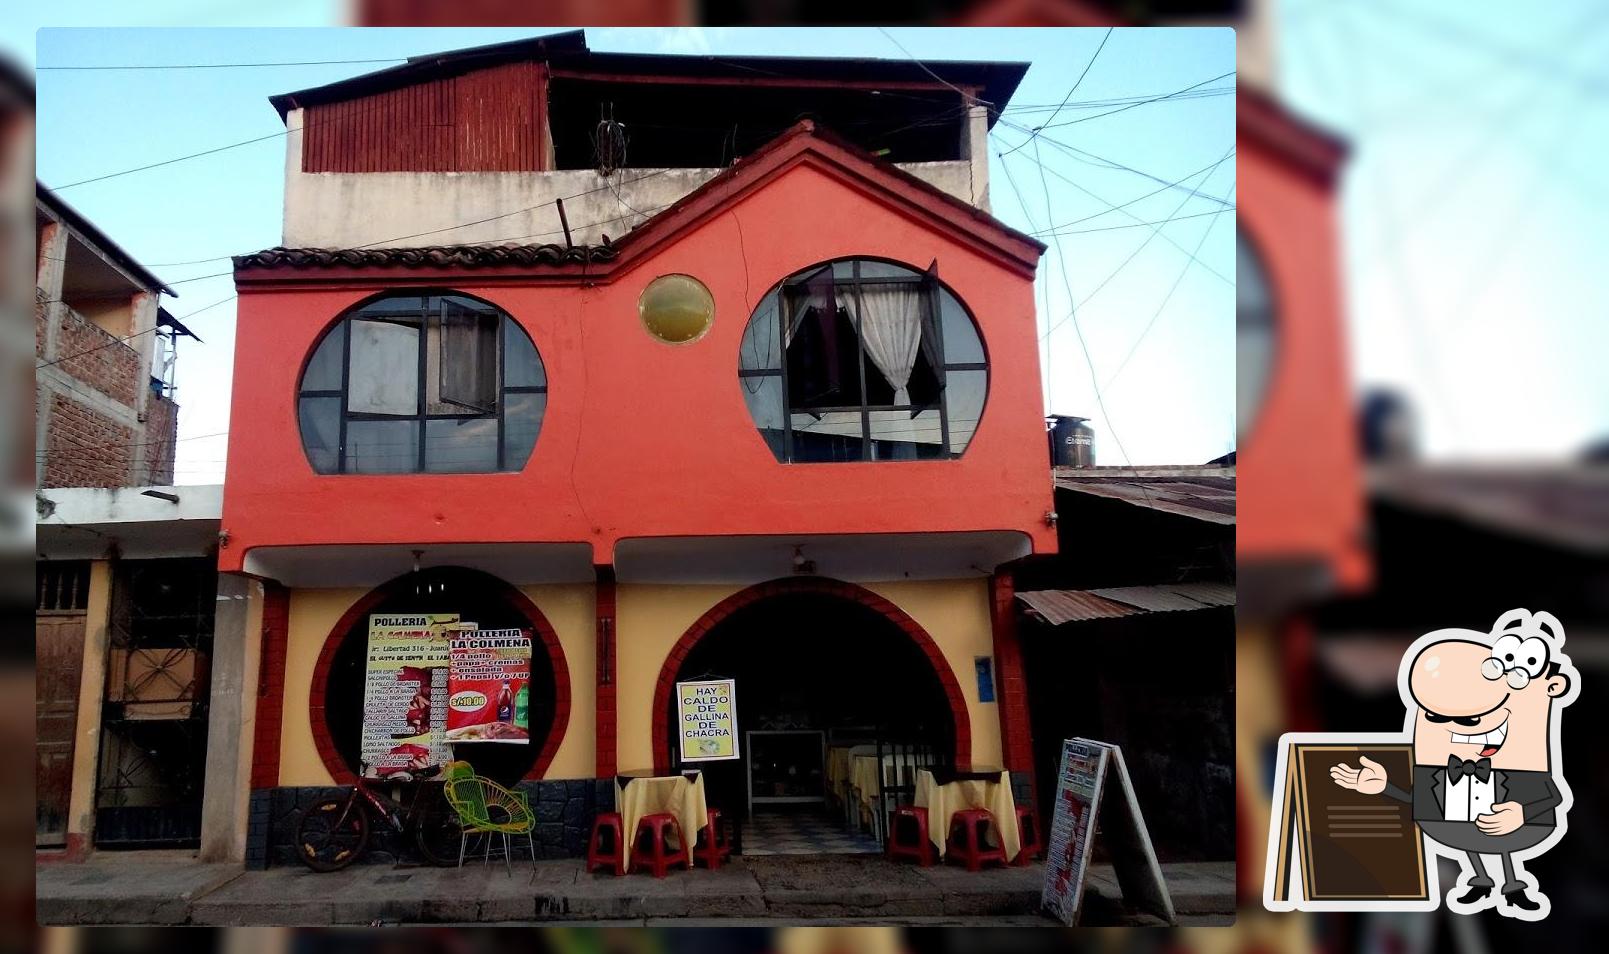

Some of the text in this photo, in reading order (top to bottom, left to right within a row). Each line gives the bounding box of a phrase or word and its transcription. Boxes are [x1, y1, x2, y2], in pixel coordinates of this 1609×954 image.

[374, 617, 427, 626] POLLERIA
[461, 629, 520, 637] POLLERIA
[451, 639, 530, 648] LA COLMENA
[683, 696, 729, 705] CALDO
[684, 713, 729, 721] GALLINA
[699, 721, 717, 729] DE
[685, 729, 730, 737] CHACRA
